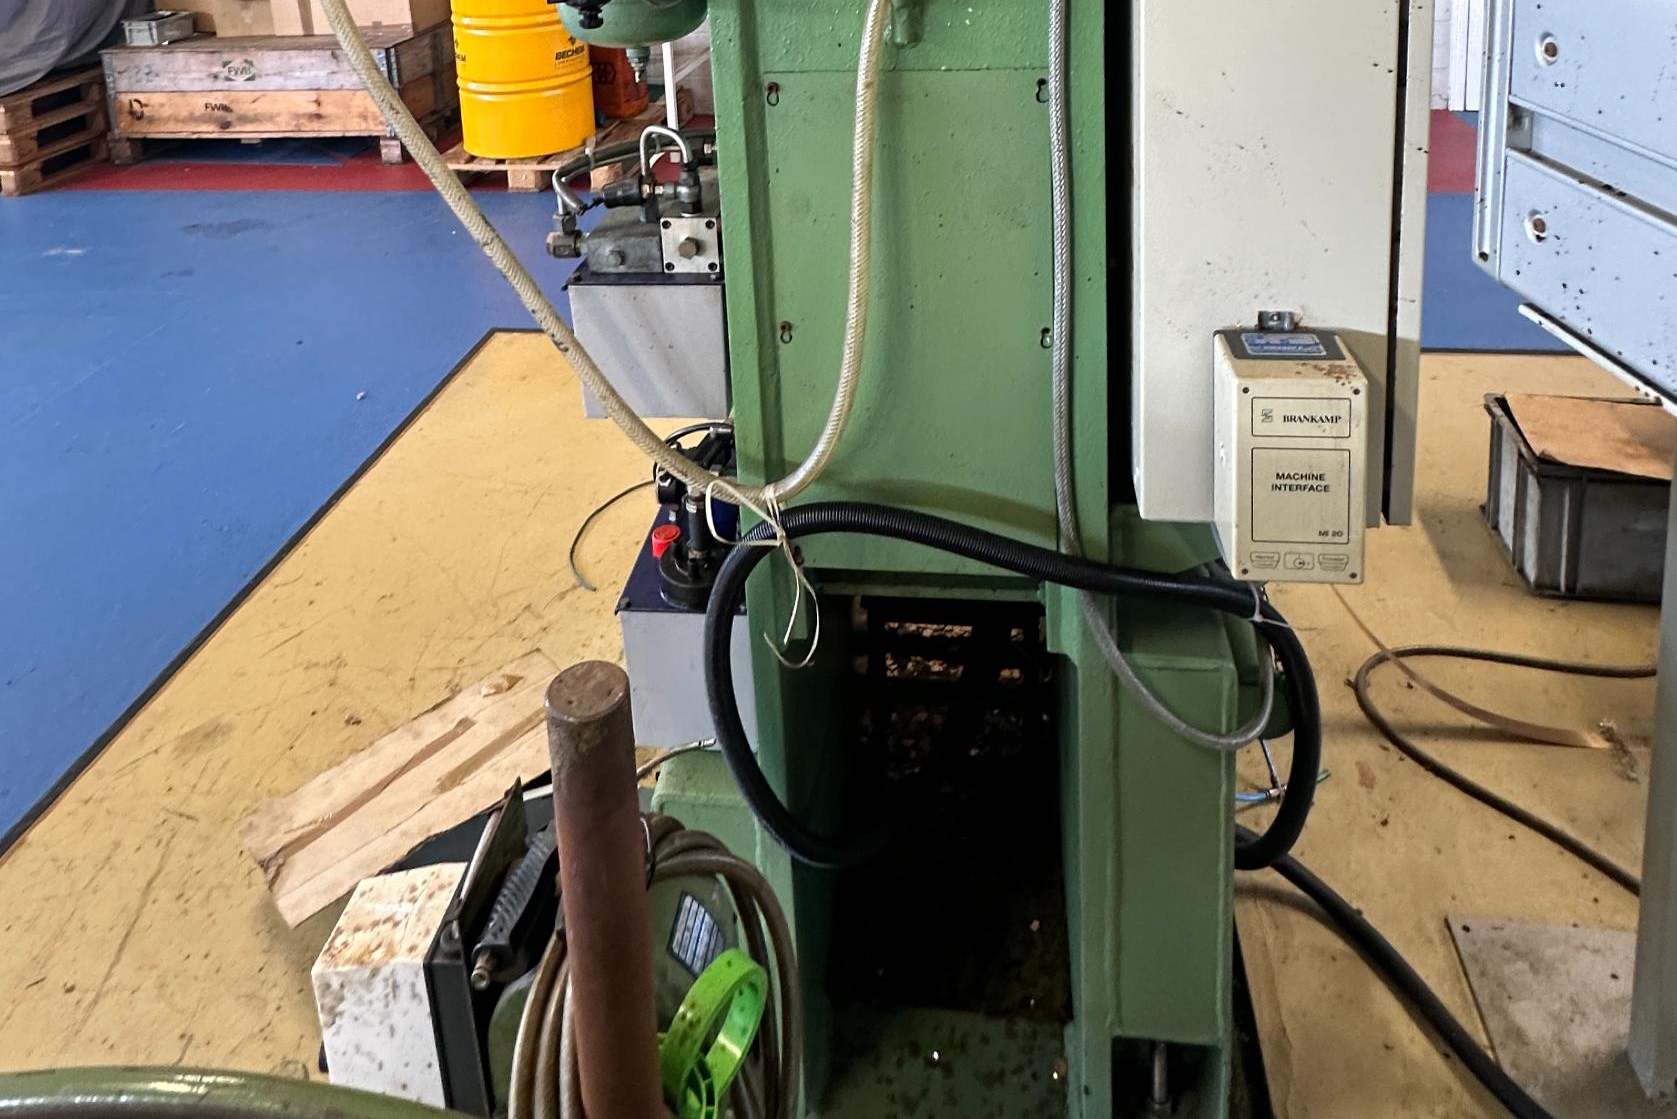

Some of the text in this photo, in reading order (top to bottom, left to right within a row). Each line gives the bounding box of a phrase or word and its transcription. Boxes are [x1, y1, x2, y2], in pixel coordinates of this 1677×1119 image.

[1283, 414, 1342, 424] BRANKAMP
[1275, 472, 1326, 482] MACHINE
[1271, 483, 1331, 493] INTERFACE
[1332, 530, 1344, 538] 20
